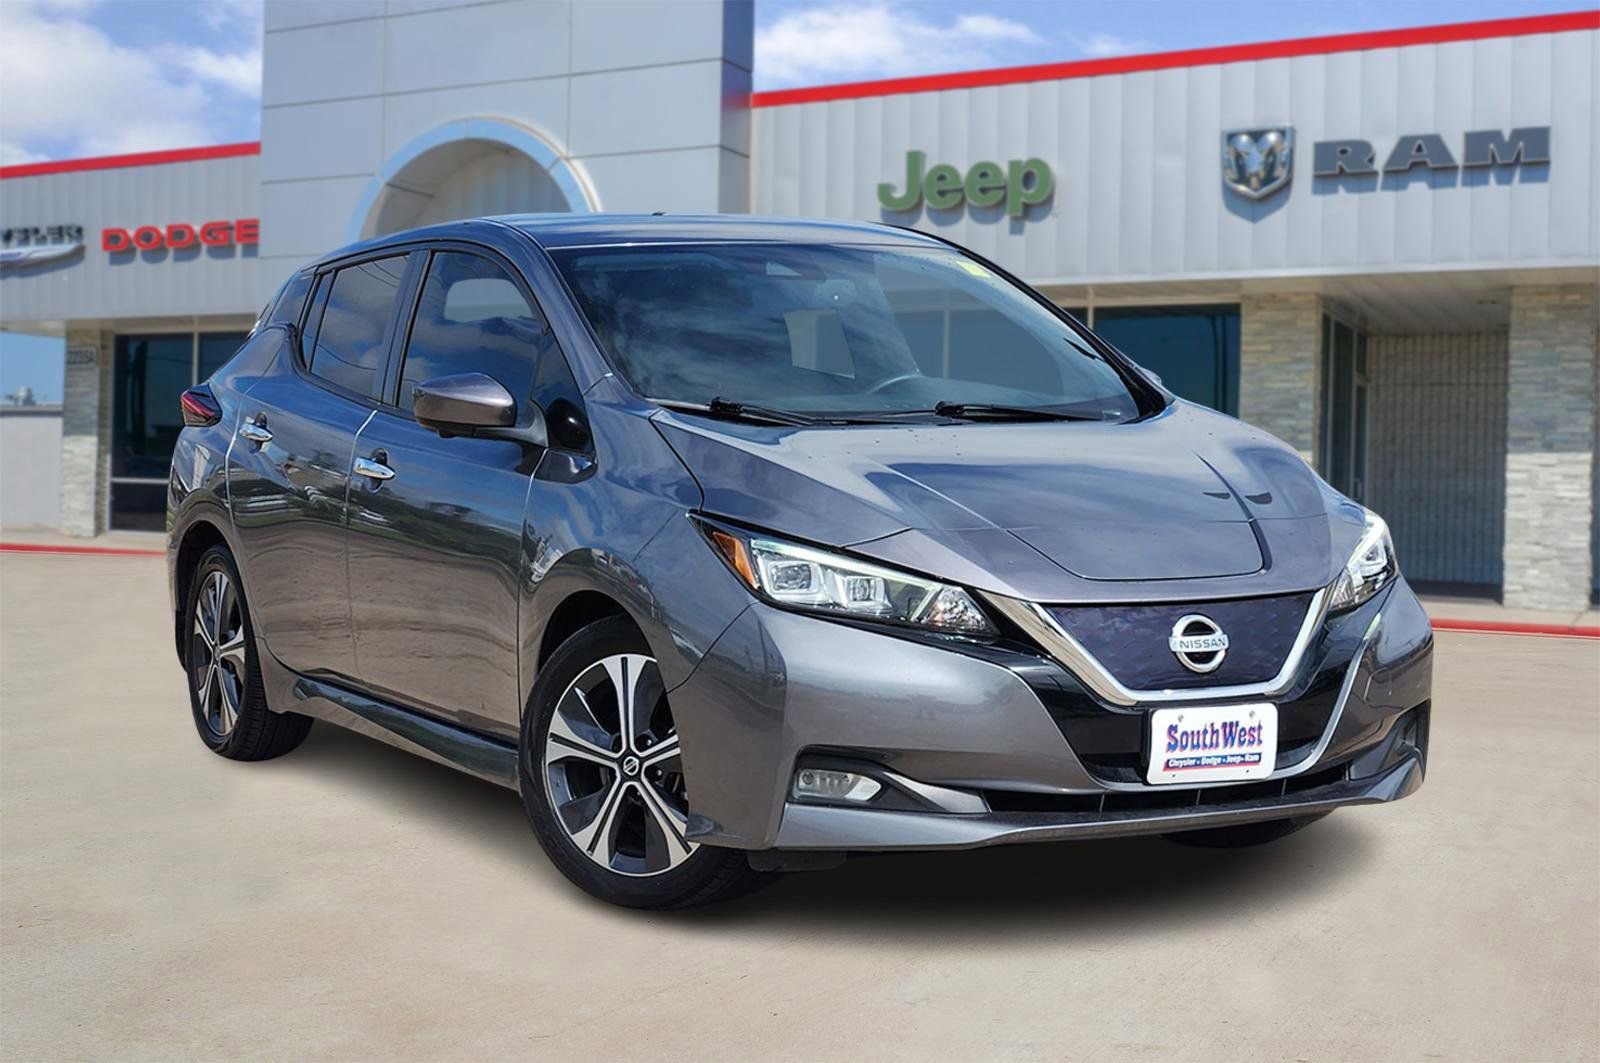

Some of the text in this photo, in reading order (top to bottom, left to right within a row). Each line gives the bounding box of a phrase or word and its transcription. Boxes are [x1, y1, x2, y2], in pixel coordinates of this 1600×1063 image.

[1313, 126, 1551, 175] RAM
[877, 150, 1053, 217] Jeep
[102, 218, 260, 251] DODGE
[1179, 638, 1226, 649] NISSAN
[1166, 720, 1263, 752] SouthWest
[1168, 758, 1196, 768] Chrysler
